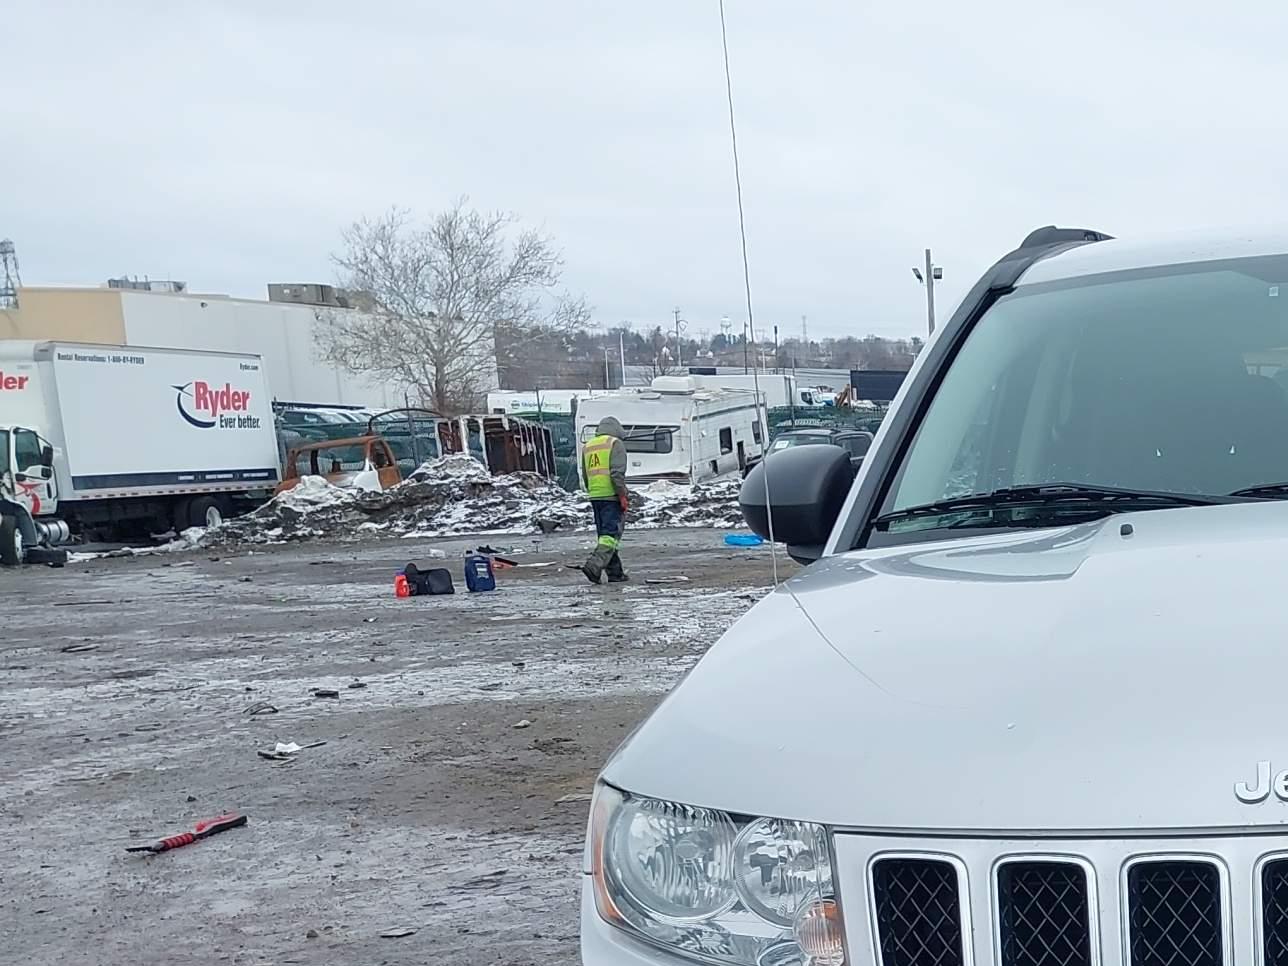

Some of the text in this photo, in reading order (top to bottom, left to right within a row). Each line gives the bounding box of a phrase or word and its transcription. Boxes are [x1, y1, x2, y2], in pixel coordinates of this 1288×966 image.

[194, 381, 250, 418] Ryder
[219, 414, 261, 429] Ever better.
